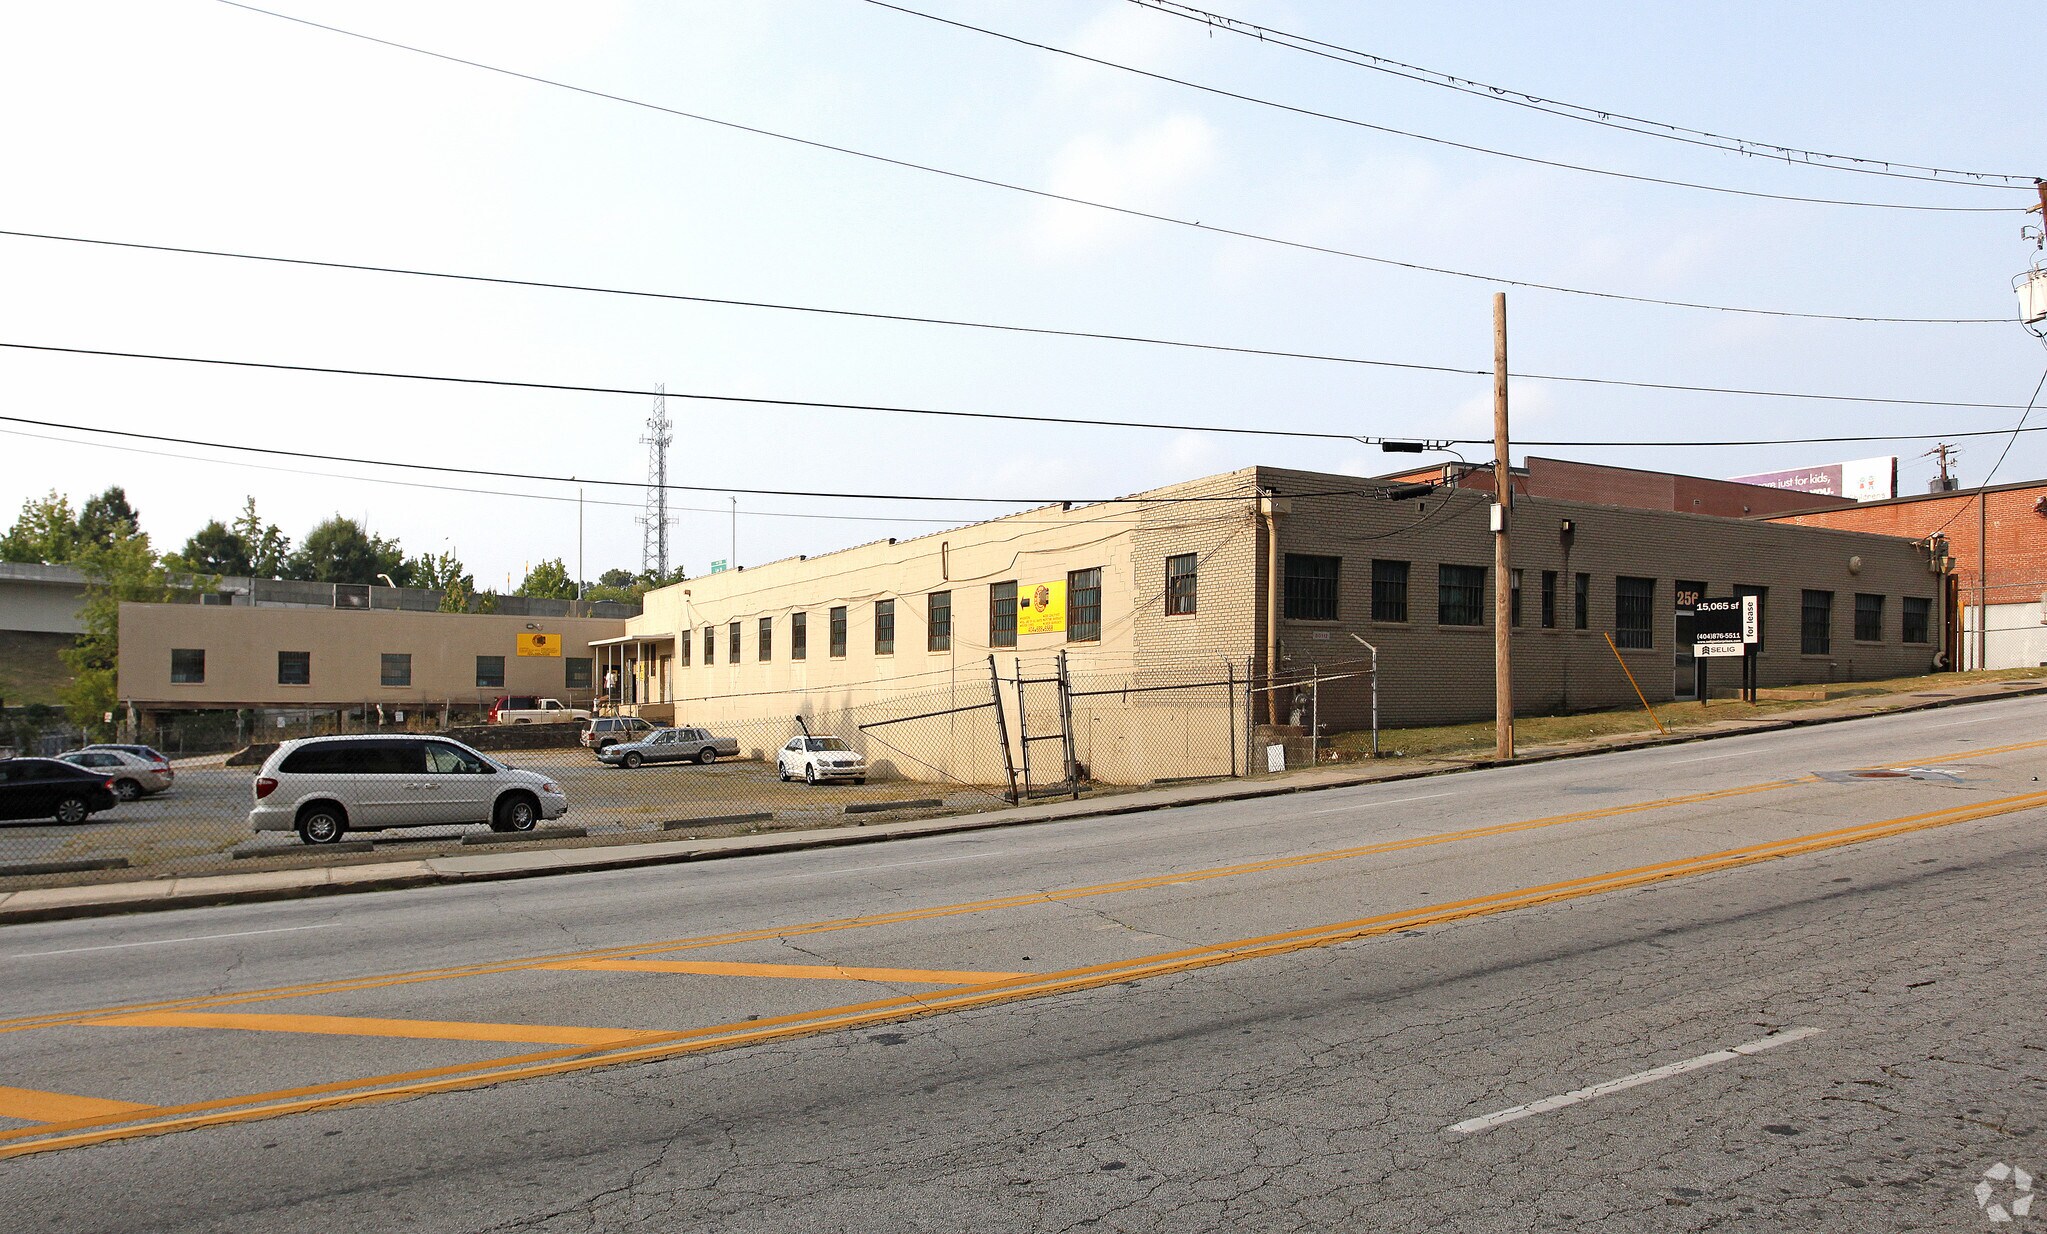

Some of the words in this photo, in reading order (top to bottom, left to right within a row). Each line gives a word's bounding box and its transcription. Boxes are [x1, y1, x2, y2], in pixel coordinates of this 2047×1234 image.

[1777, 478, 1793, 489] just
[1794, 475, 1808, 486] for
[1809, 472, 1831, 484] kids,
[1697, 602, 1729, 611] 15,065
[1746, 601, 1754, 624] lease
[1746, 625, 1754, 638] for
